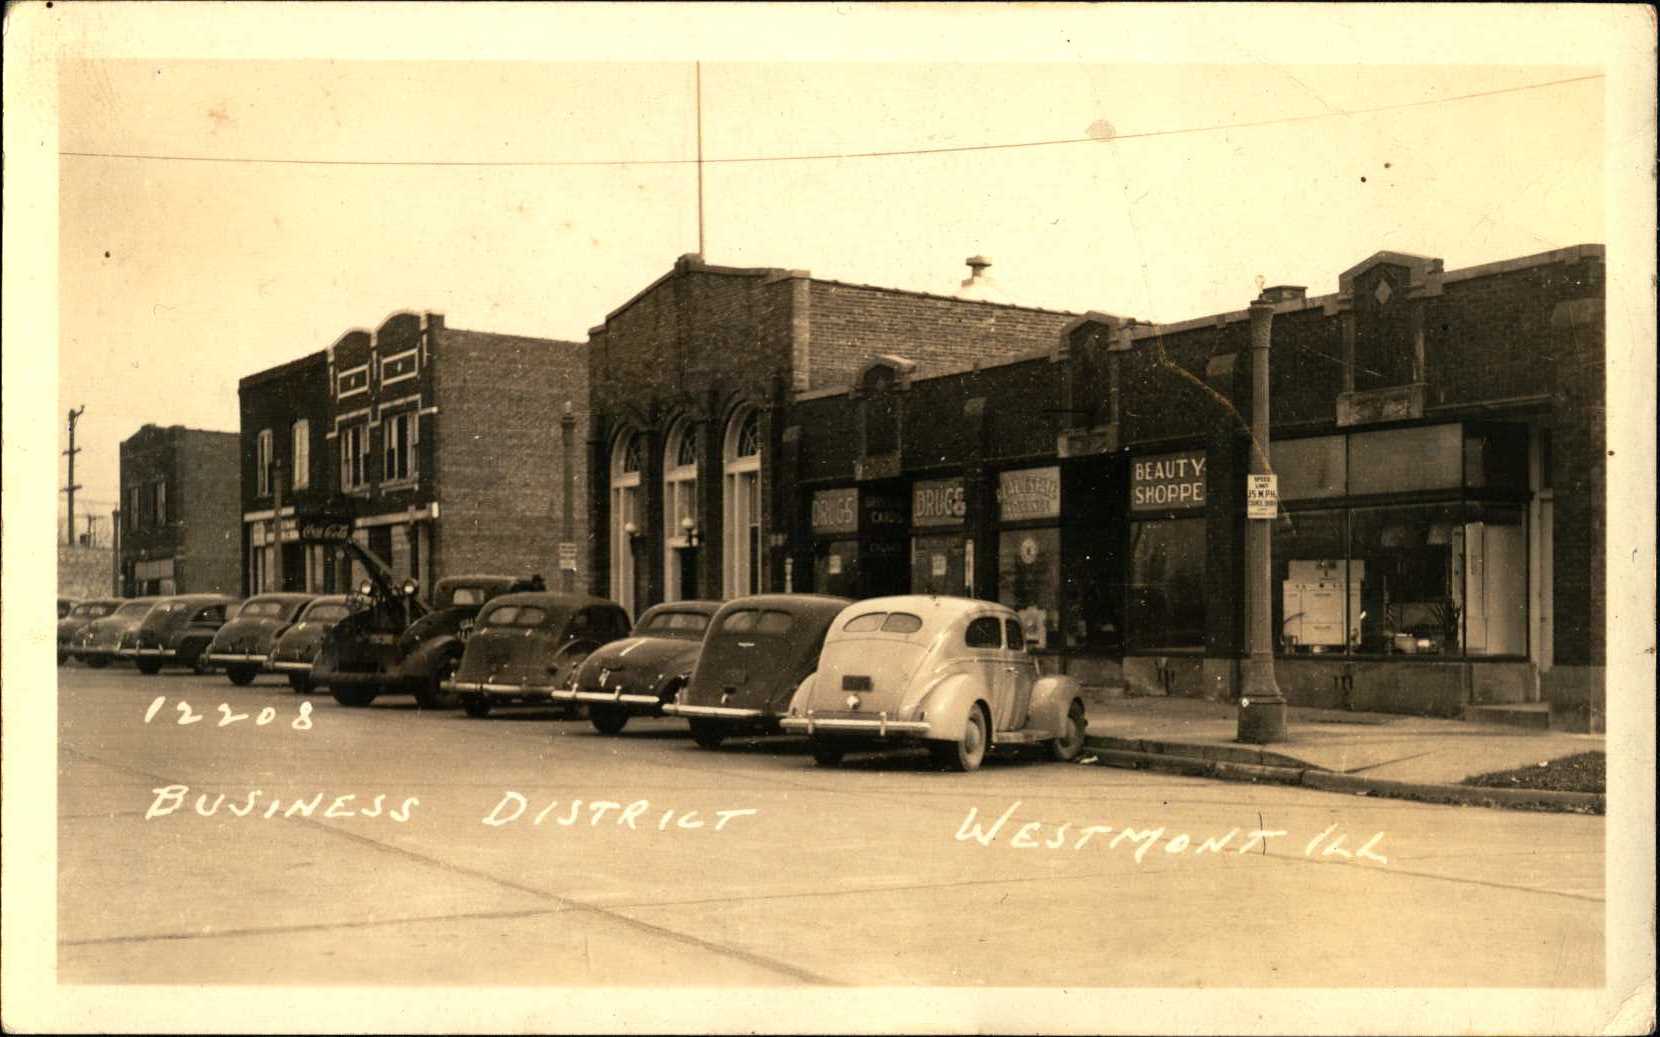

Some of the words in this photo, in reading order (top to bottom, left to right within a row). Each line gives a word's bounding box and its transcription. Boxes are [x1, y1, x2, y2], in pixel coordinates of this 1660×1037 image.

[1135, 457, 1206, 481] BEAUTY
[1135, 482, 1204, 505] SHOPPE
[811, 496, 855, 527] DRUGS
